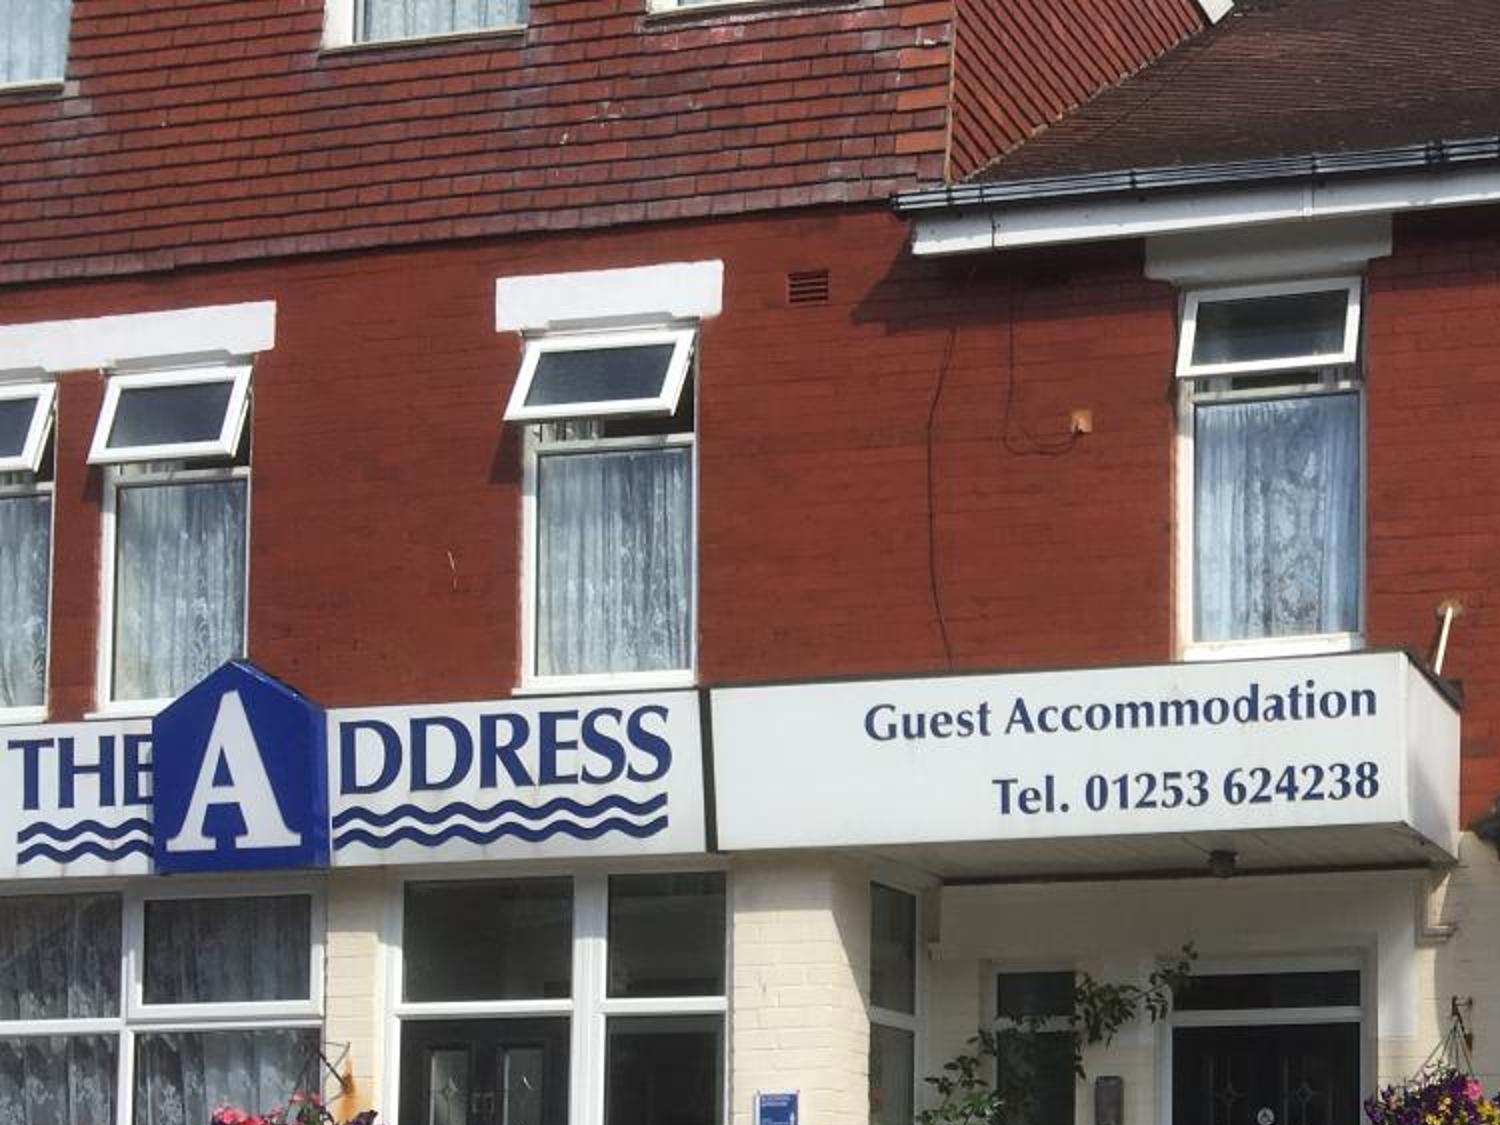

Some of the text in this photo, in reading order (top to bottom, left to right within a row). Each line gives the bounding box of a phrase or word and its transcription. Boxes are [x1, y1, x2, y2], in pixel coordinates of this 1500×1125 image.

[864, 679, 1377, 741] Guest Accommodation
[8, 734, 152, 810] THE
[992, 761, 1380, 816] Tel. 01253 624238
